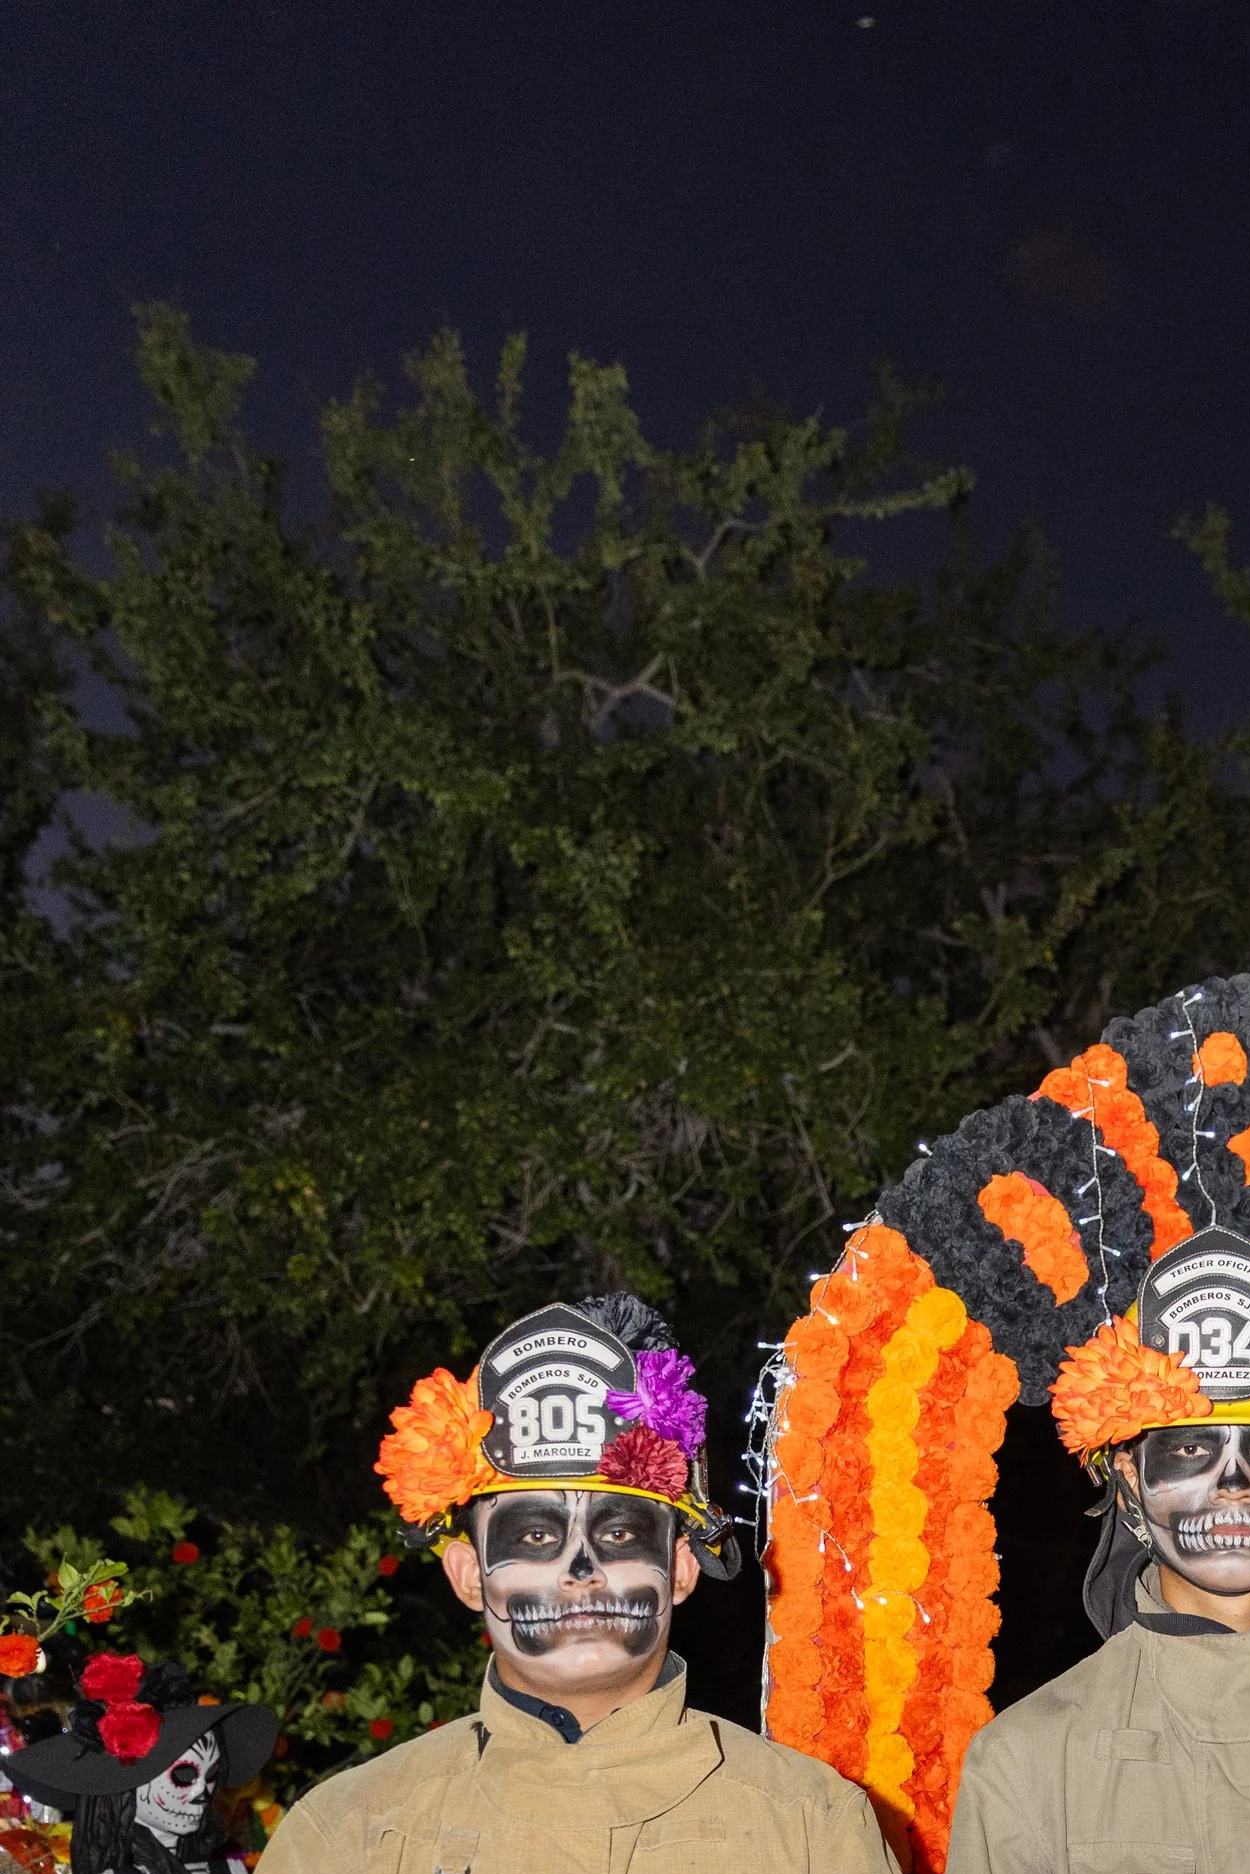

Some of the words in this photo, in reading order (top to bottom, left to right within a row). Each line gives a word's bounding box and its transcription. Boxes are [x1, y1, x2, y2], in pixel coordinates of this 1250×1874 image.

[1169, 1259, 1215, 1279] TERCER
[1169, 1292, 1232, 1320] BOMBEROS
[513, 1336, 588, 1357] BOMBERO
[508, 1369, 571, 1400] BOMBEROS
[577, 1373, 599, 1389] SJD
[1197, 1371, 1250, 1379] ONZALEZ
[508, 1394, 606, 1447] 805
[520, 1451, 530, 1460] J.
[533, 1447, 592, 1458] MARQUEZ
